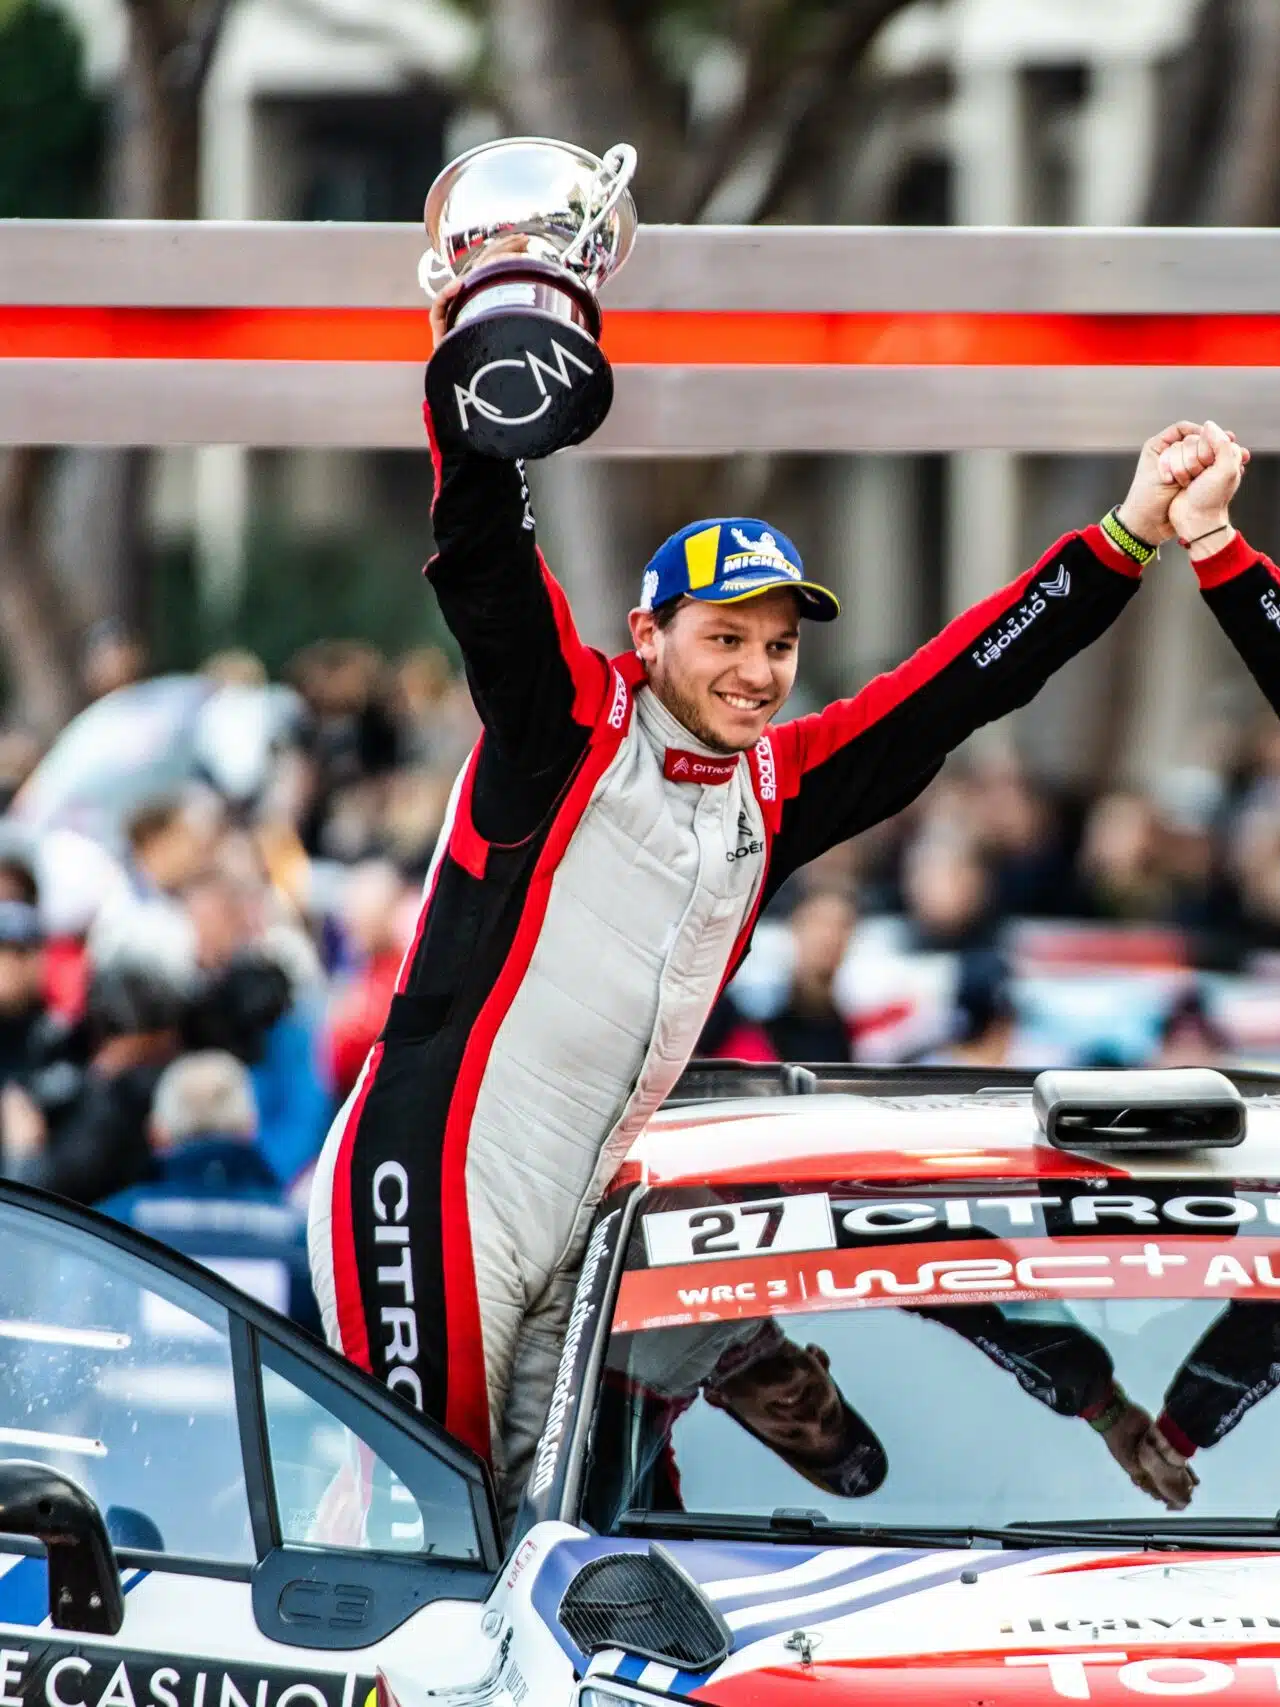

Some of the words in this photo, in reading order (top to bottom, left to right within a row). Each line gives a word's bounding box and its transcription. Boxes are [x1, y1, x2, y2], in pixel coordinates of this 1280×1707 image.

[688, 1201, 787, 1256] 27
[371, 1160, 424, 1414] CITRO
[677, 1283, 757, 1306] WRC
[765, 1278, 789, 1299] 3
